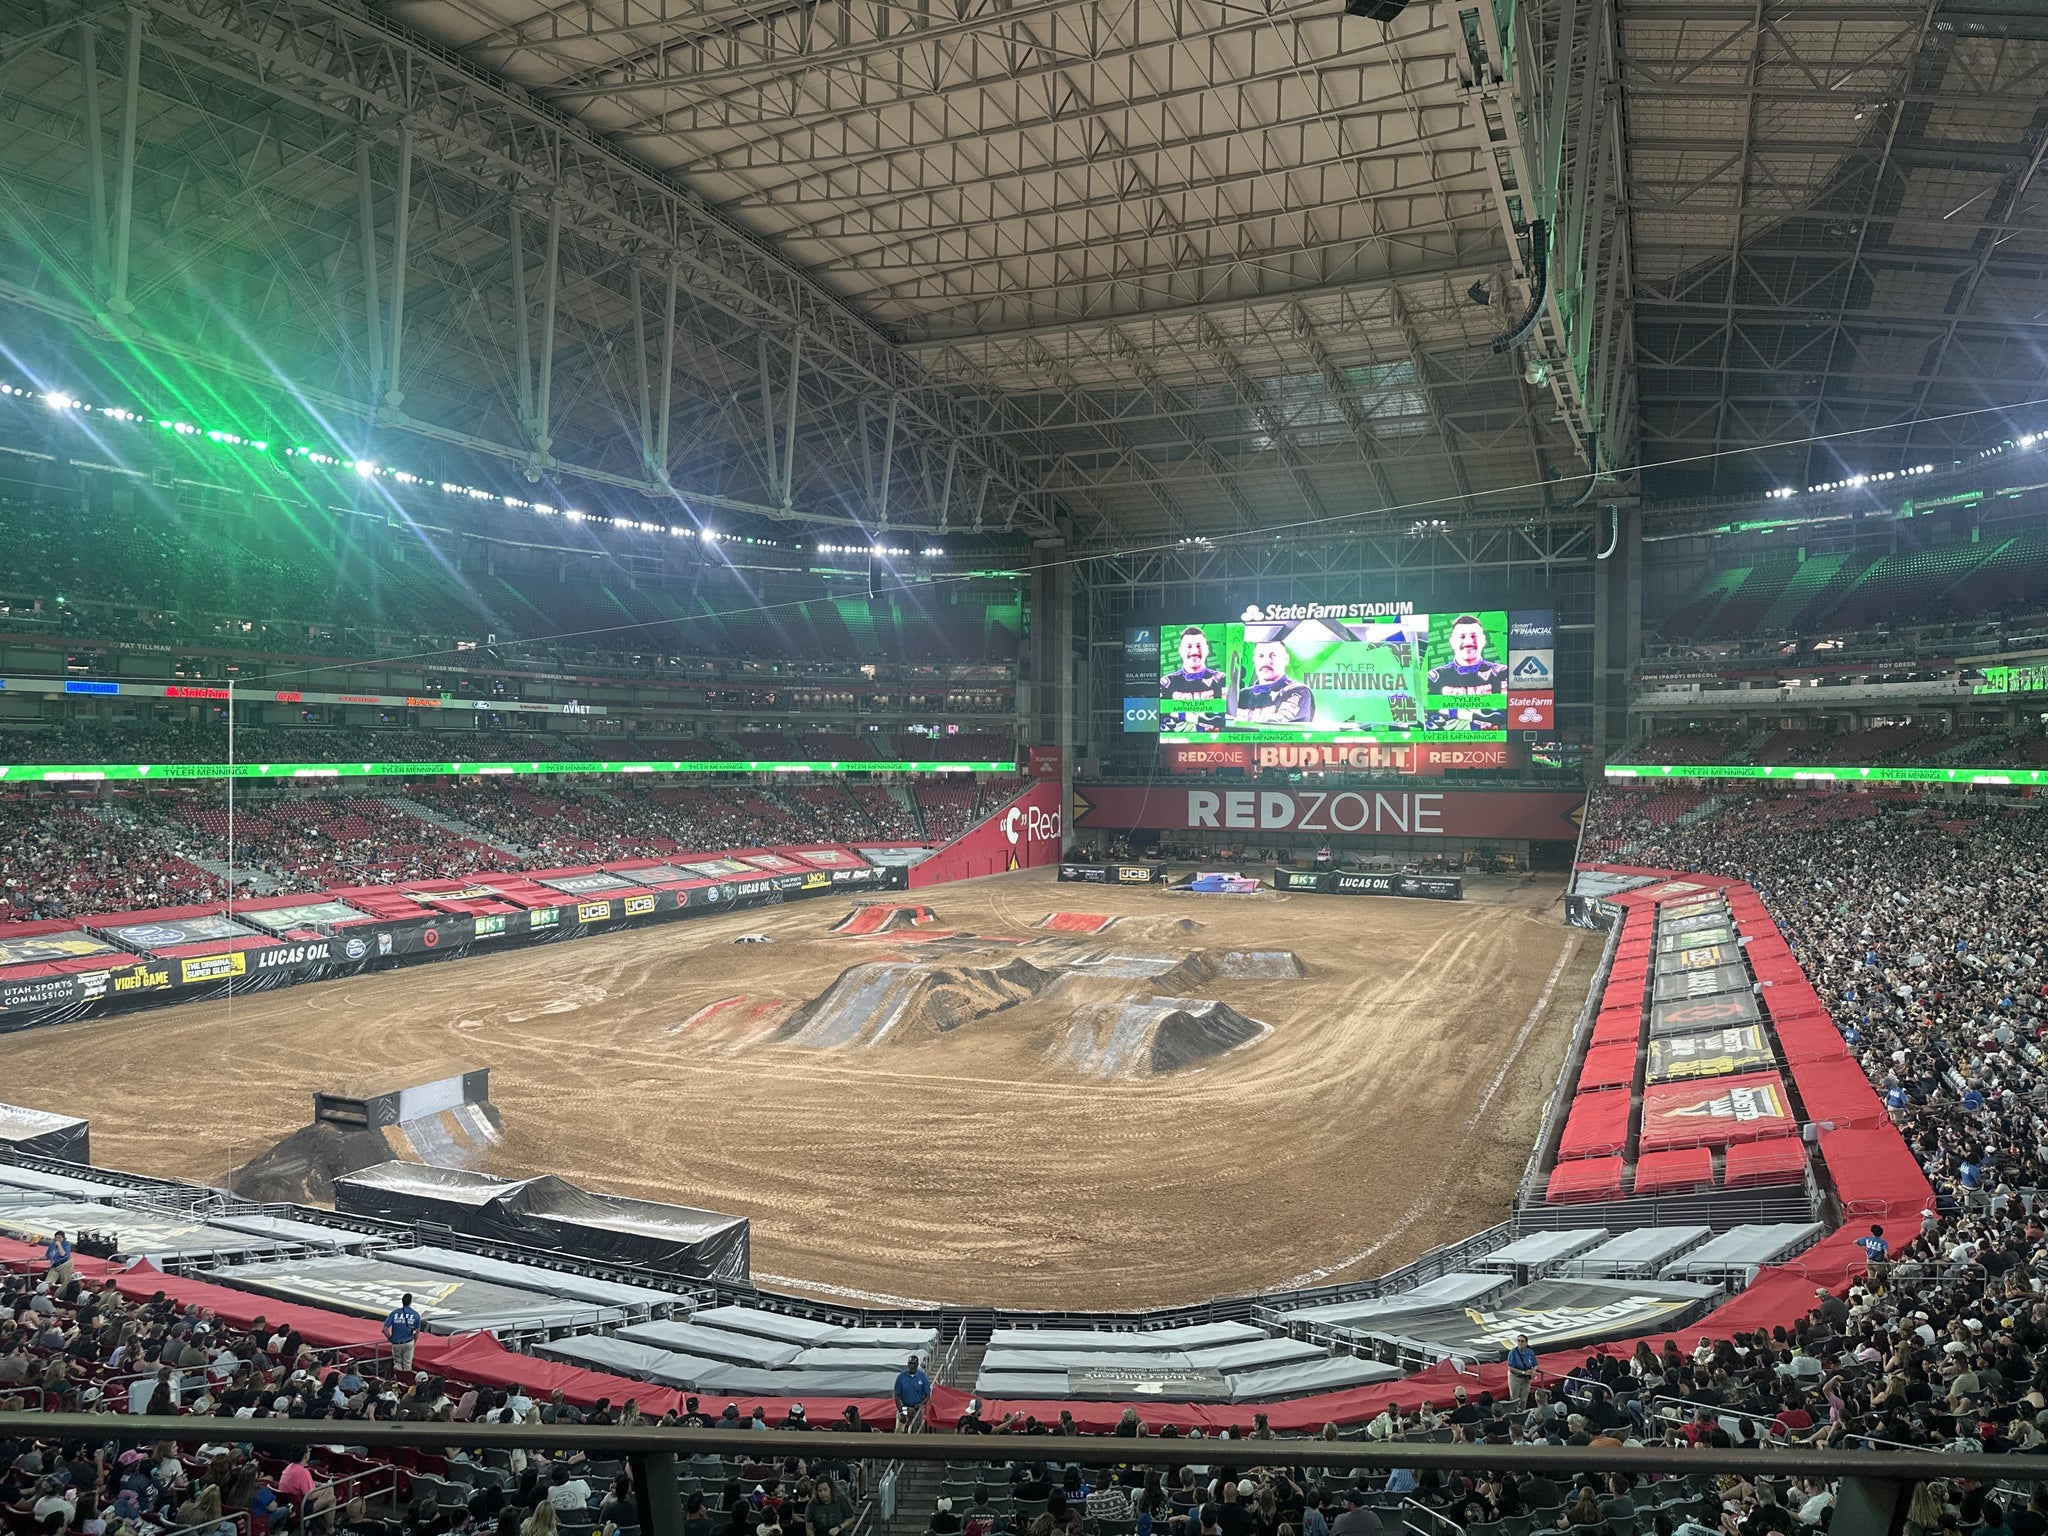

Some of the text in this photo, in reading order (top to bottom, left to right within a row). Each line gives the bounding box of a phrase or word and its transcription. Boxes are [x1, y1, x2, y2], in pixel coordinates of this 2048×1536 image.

[1349, 601, 1413, 617] STADIUM
[136, 643, 171, 652] TILLMAN
[1335, 663, 1375, 672] TYLER
[1303, 672, 1409, 691] MENNINGA
[1513, 675, 1549, 683] Albertsons
[1658, 673, 1686, 681] (PADDY)
[1687, 672, 1718, 680] DRISCOLL
[1126, 709, 1158, 721] COX
[1178, 751, 1243, 763] REDZONE
[1260, 746, 1409, 768] BUD LIGHT
[1429, 752, 1507, 764] REDZONE
[163, 768, 248, 777] TYLER MENNINGA
[380, 766, 445, 774] TYLER MENNINGA
[1682, 769, 1756, 777] TYLER MENNINGA
[1880, 771, 1941, 780] TYLER MENNINGA
[1187, 790, 1444, 833] REDZONE
[1028, 804, 1062, 842] Red
[1121, 870, 1148, 878] JCB
[1290, 875, 1317, 885] BKT
[738, 880, 771, 895] LUCAS OIL
[1339, 877, 1372, 888] LUCAS
[1373, 879, 1390, 889] OIL
[627, 897, 653, 912] JCB
[531, 910, 559, 925] BKT
[580, 905, 607, 920] JCB
[476, 917, 505, 932] BKT
[258, 946, 303, 968] LUCAS
[306, 943, 331, 960] OIL
[133, 965, 148, 977] THE
[186, 962, 200, 971] THE
[186, 965, 231, 978] SUPER GLUE
[114, 975, 141, 991] VIDEO
[142, 970, 169, 987] GAME
[4, 986, 32, 996] UTAH
[35, 979, 73, 992] SPORTS
[4, 988, 74, 1006] COMMISSION
